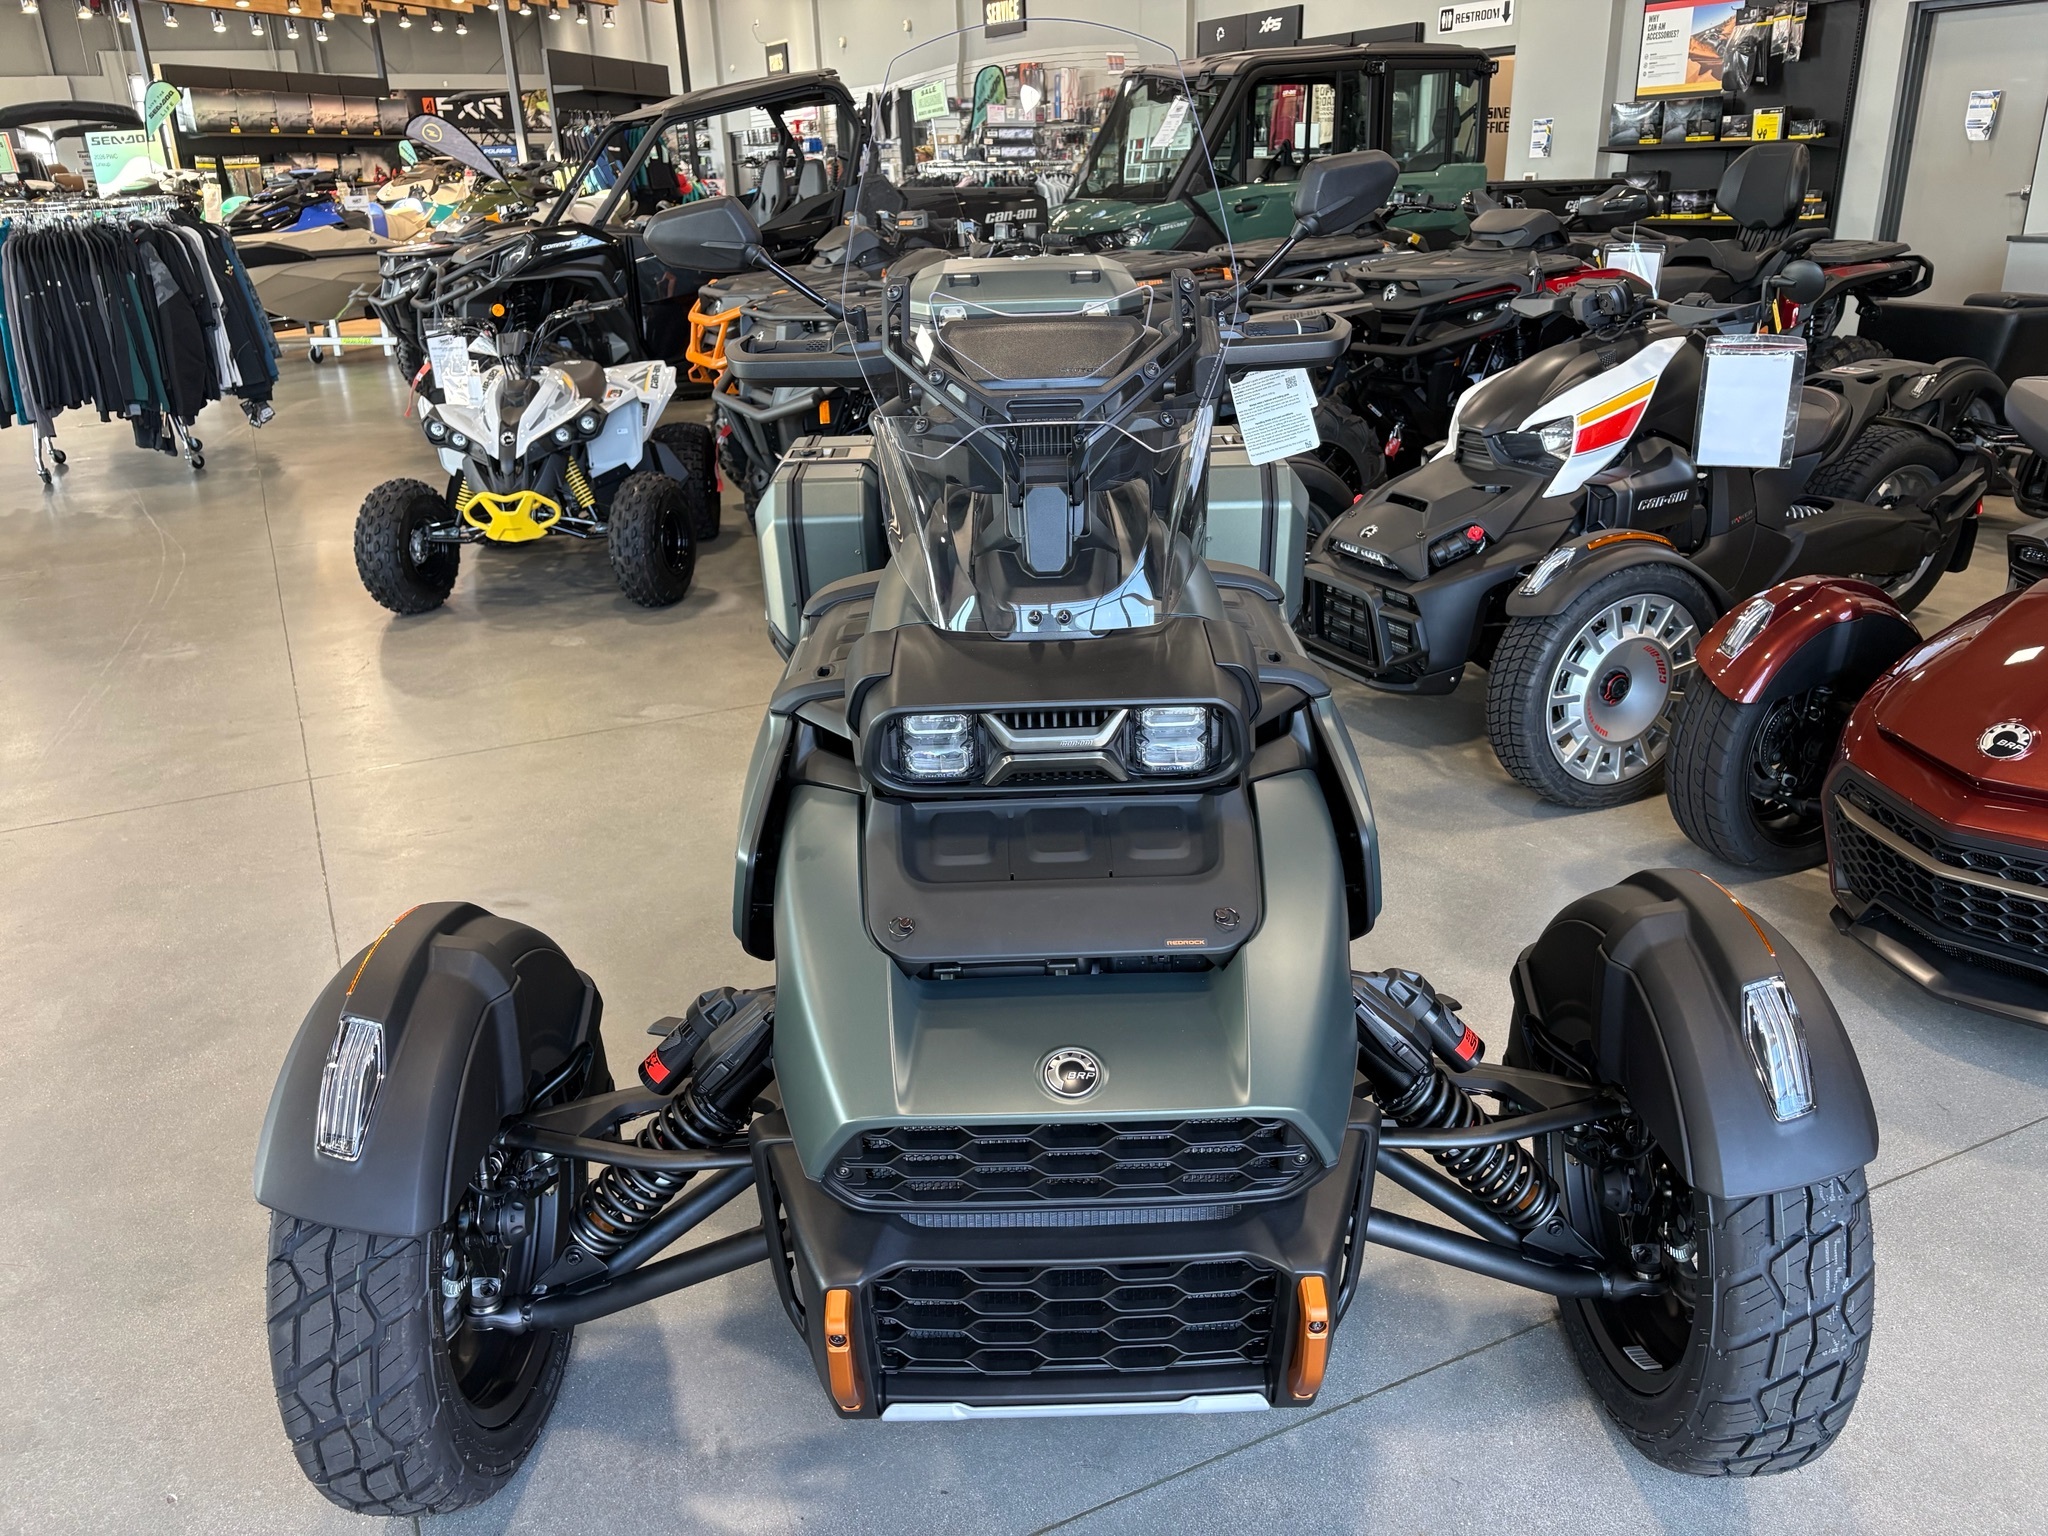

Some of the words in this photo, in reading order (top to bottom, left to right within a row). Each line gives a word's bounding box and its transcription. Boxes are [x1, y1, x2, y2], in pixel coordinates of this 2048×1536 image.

[986, 0, 1020, 25] SERVICE
[1455, 8, 1500, 24] RESTROOM
[1648, 14, 1660, 23] WHY
[1259, 16, 1283, 33] XPS
[1648, 24, 1657, 32] CAN
[1658, 22, 1666, 30] AM
[1646, 29, 1679, 41] ACCESSORIES?
[920, 86, 937, 97] SALE
[1996, 739, 2025, 750] BRP
[1067, 1071, 1096, 1080] BRP
